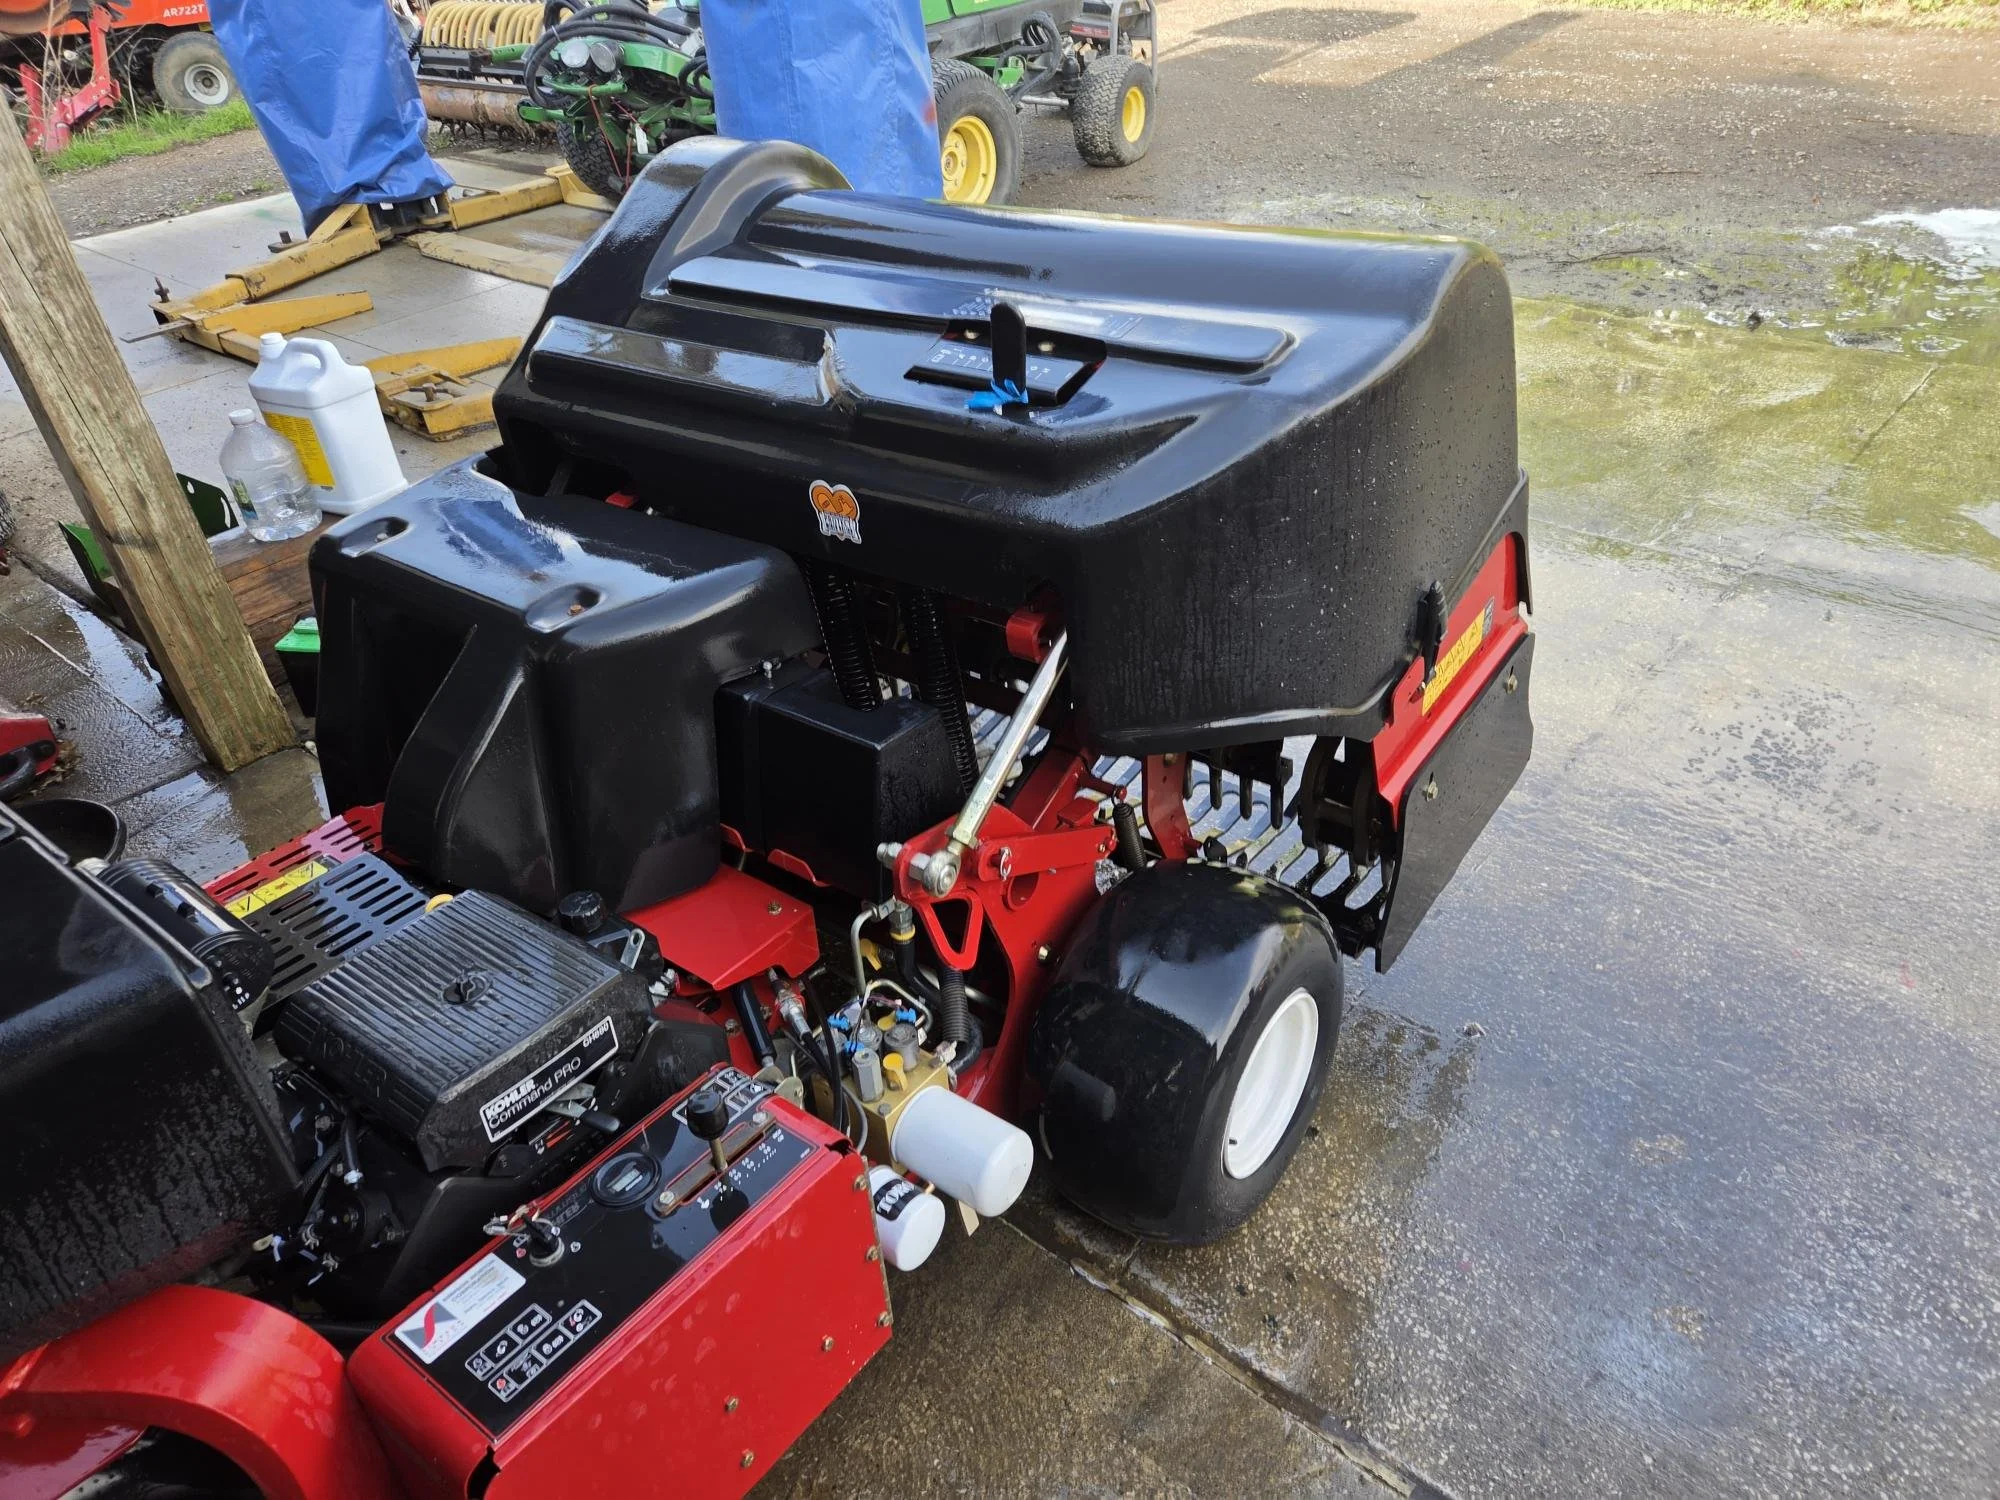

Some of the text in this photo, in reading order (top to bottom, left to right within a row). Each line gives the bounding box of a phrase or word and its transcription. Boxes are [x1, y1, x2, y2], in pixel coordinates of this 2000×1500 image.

[163, 4, 205, 18] AR722T
[484, 1078, 536, 1120] KOHLER
[488, 1077, 554, 1129] Command
[554, 1056, 582, 1083] PRO
